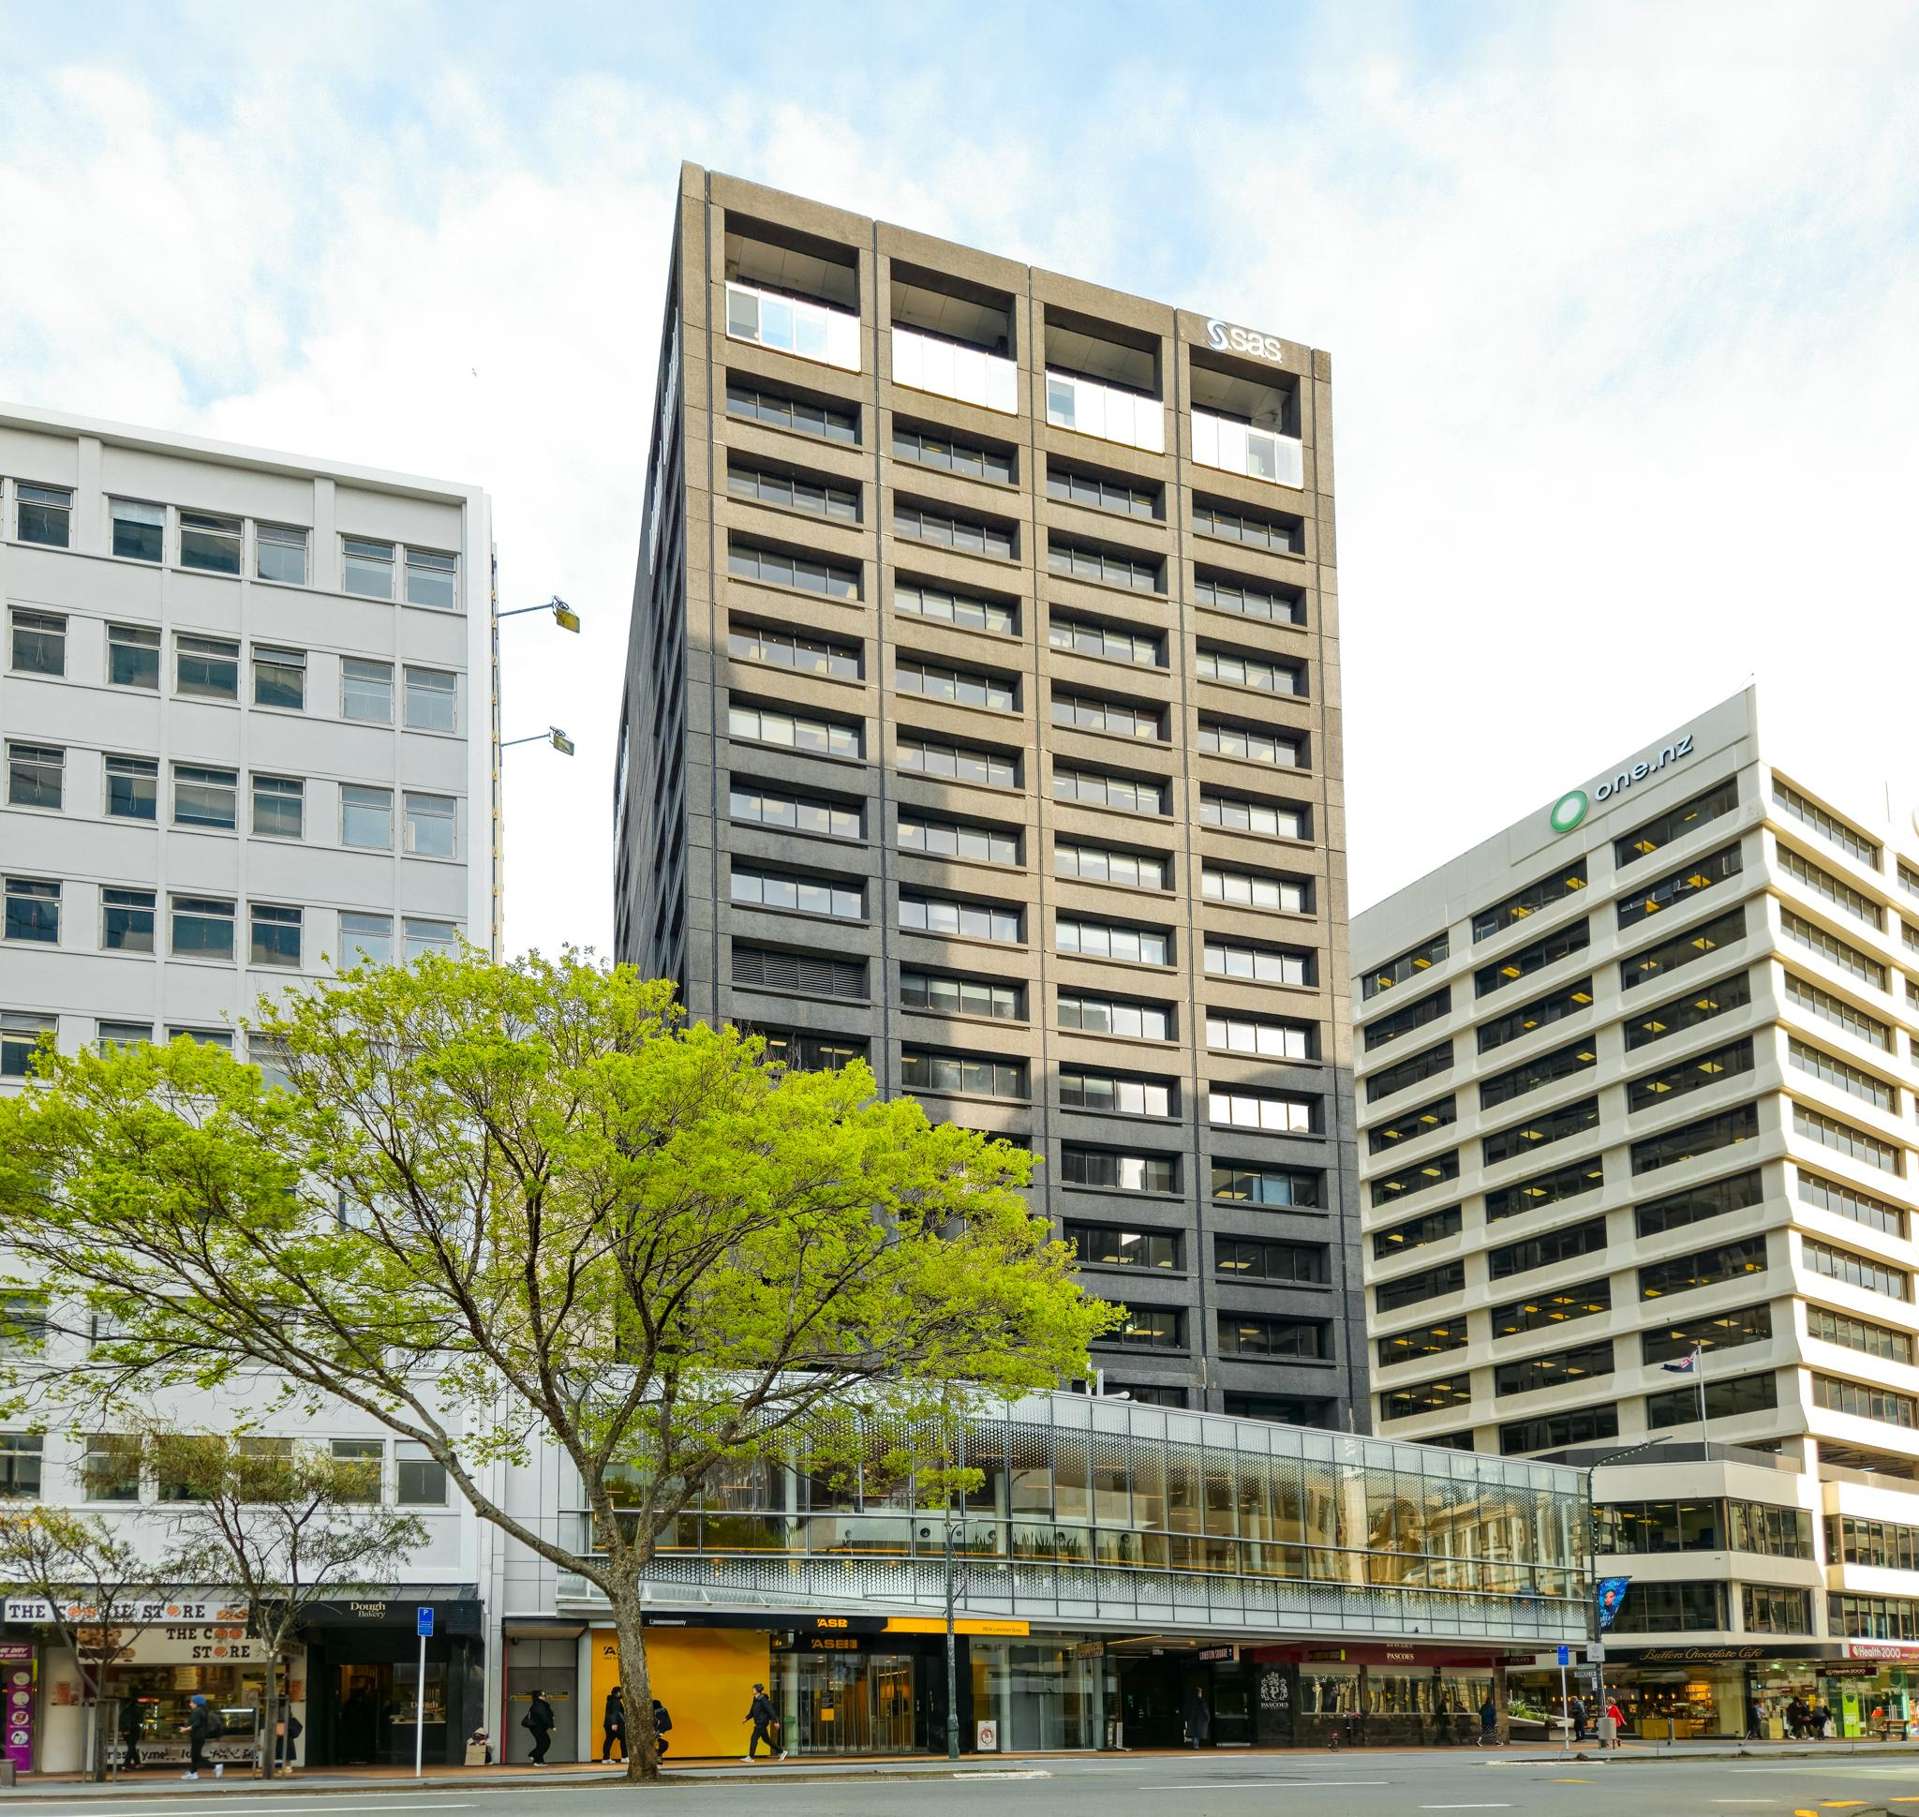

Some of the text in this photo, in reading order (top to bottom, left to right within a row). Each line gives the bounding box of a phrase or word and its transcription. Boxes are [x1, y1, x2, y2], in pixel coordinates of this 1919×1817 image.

[1230, 326, 1282, 364] sas
[1594, 734, 1694, 802] one.nz
[9, 1604, 46, 1618] THE
[142, 1605, 206, 1618] STORE
[350, 1602, 386, 1615] Dough
[358, 1611, 386, 1619] Bakery
[166, 1628, 197, 1640] THE
[192, 1645, 251, 1659] STORE
[1685, 1647, 1736, 1659] Chocolate
[1882, 1648, 1901, 1658] 2000
